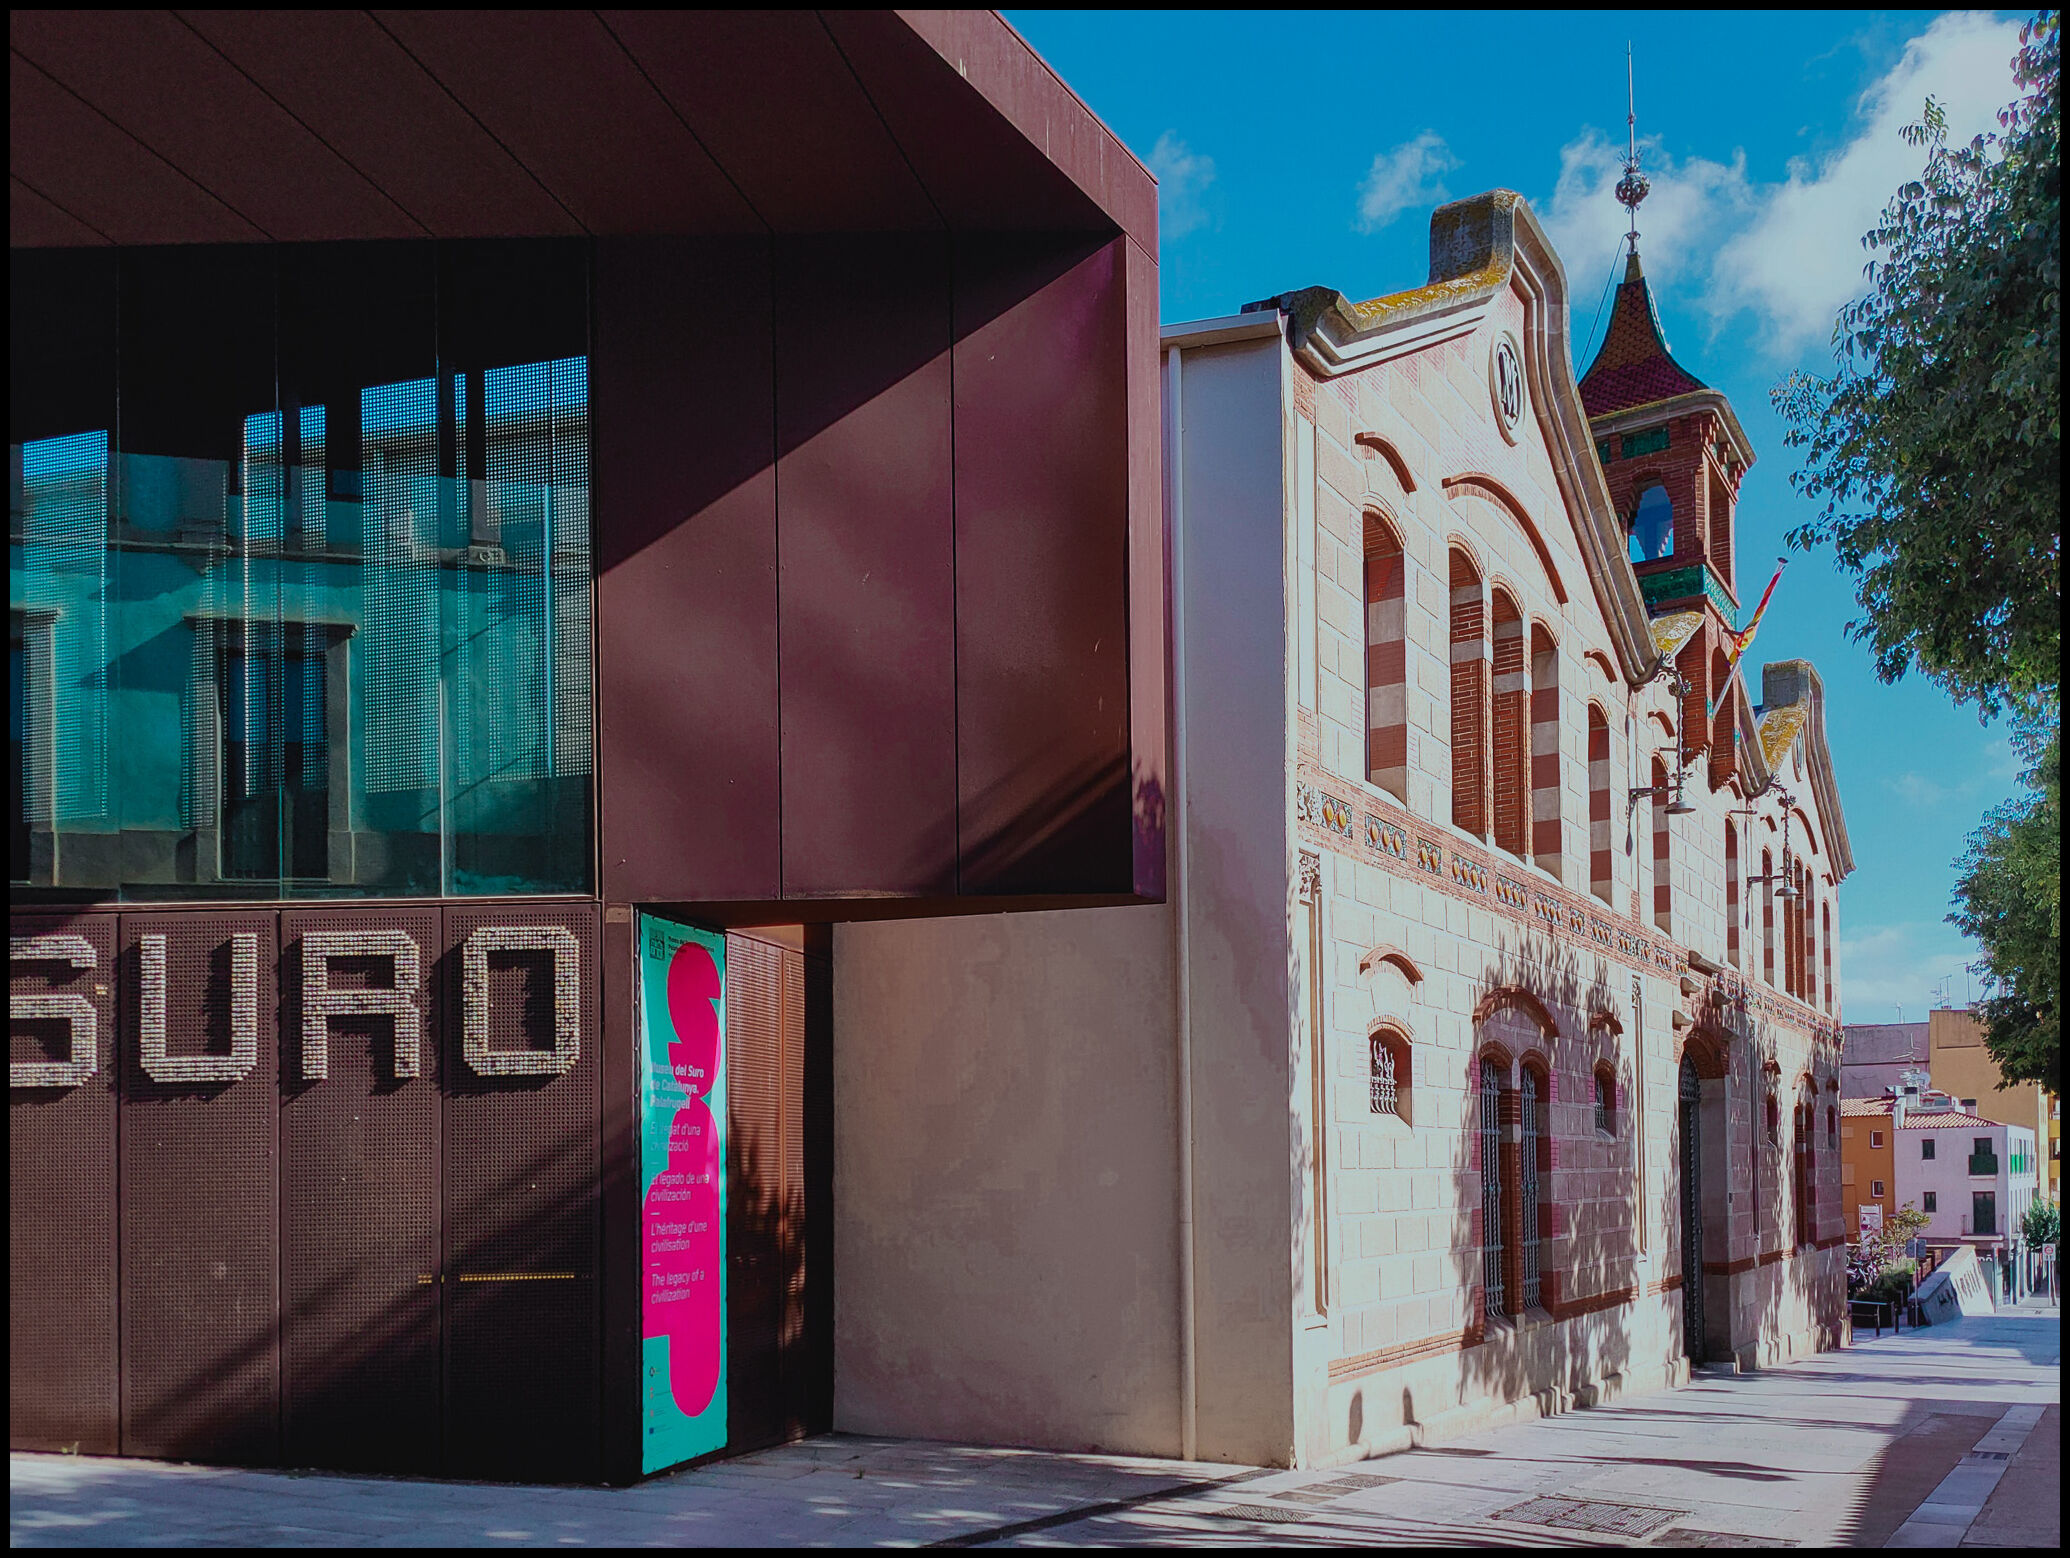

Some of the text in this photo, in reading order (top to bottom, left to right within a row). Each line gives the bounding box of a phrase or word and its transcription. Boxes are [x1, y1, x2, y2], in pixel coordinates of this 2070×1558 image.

[675, 1064, 687, 1076] del
[688, 1065, 704, 1078] Suro
[660, 1172, 684, 1188] legado
[686, 1172, 695, 1185] de
[696, 1174, 710, 1184] una
[652, 1268, 705, 1287] The legacy of a
